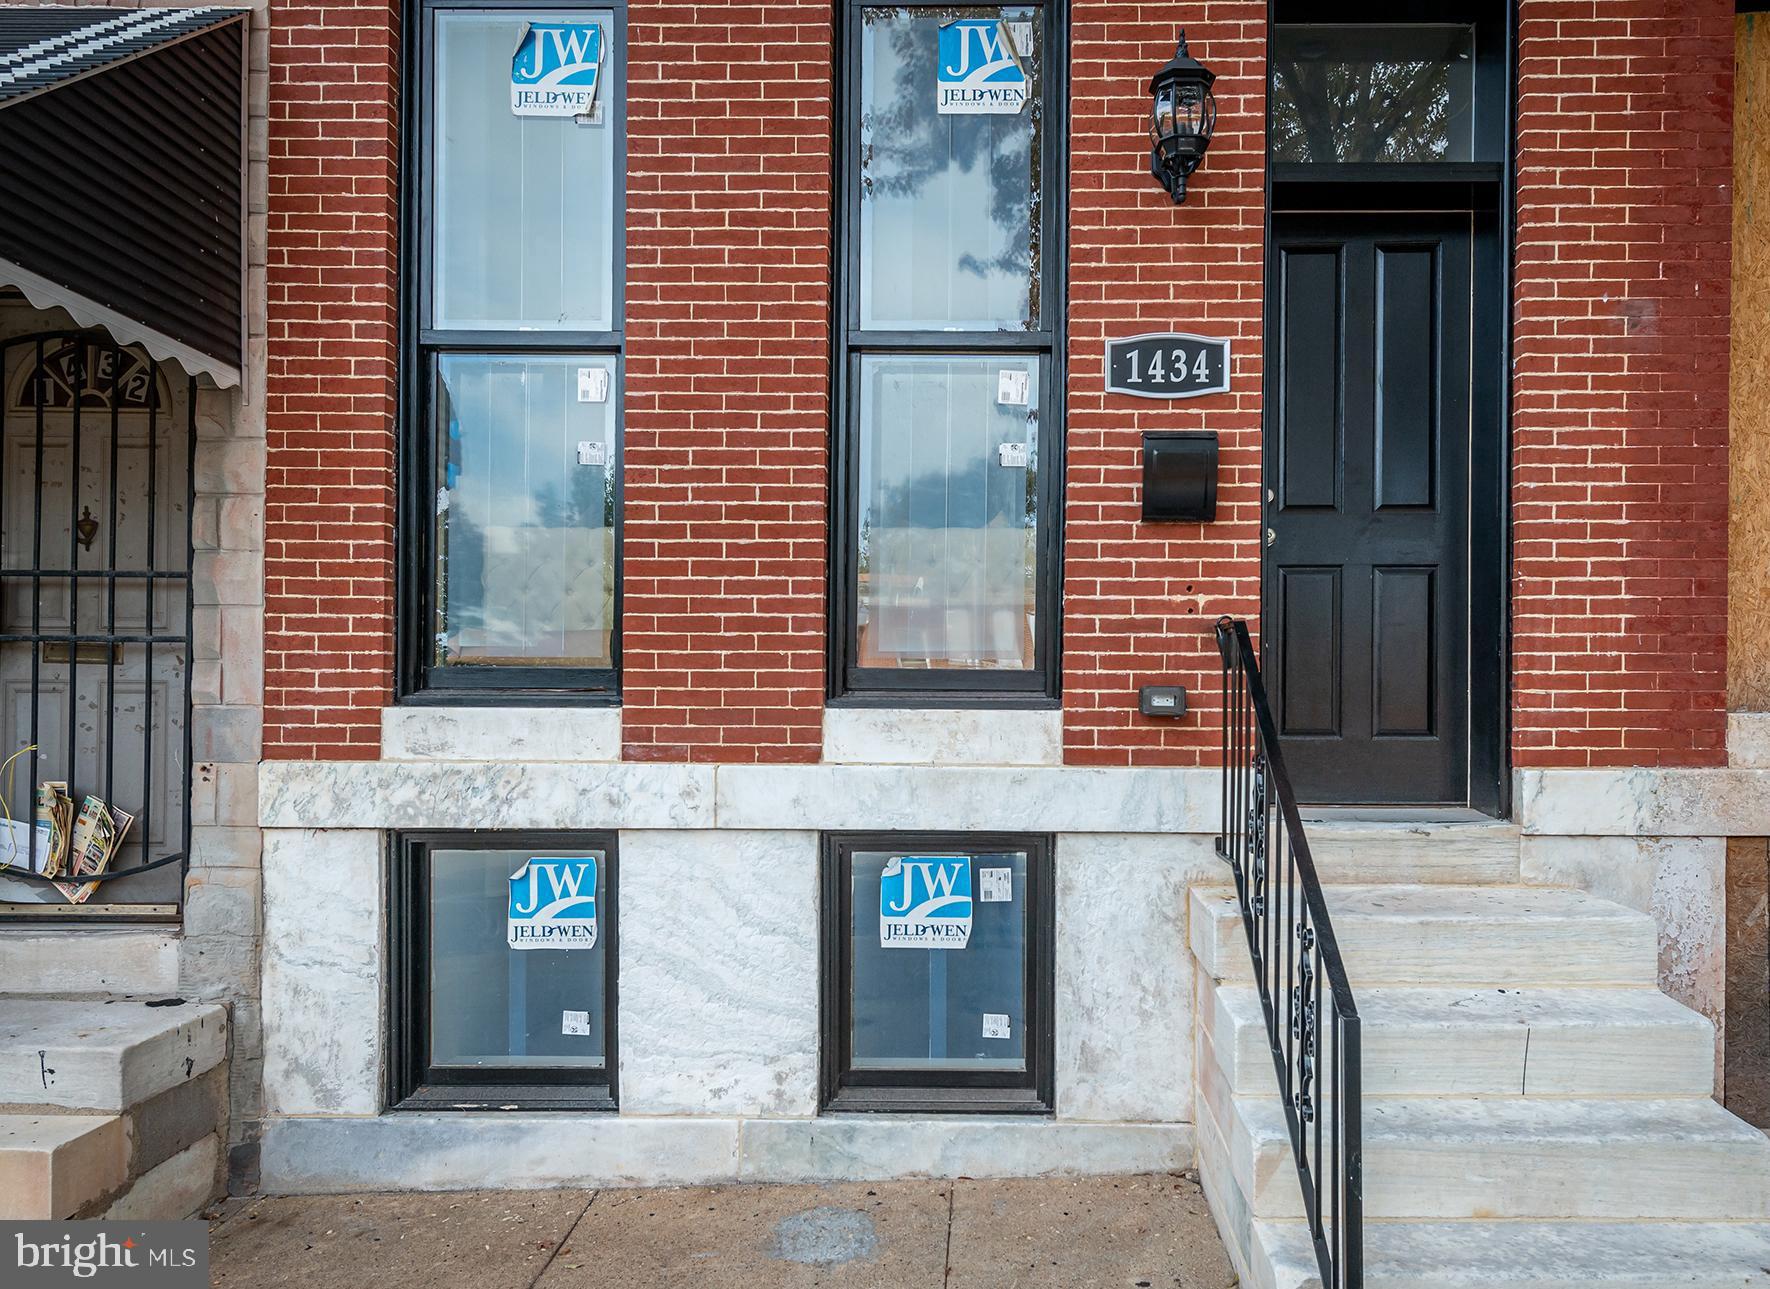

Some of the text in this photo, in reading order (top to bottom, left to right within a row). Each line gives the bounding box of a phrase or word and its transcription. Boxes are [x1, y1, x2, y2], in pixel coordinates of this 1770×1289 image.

[520, 28, 596, 79] JW
[1126, 349, 1210, 383] 1434
[515, 864, 589, 913] JW
[889, 863, 964, 911] JW
